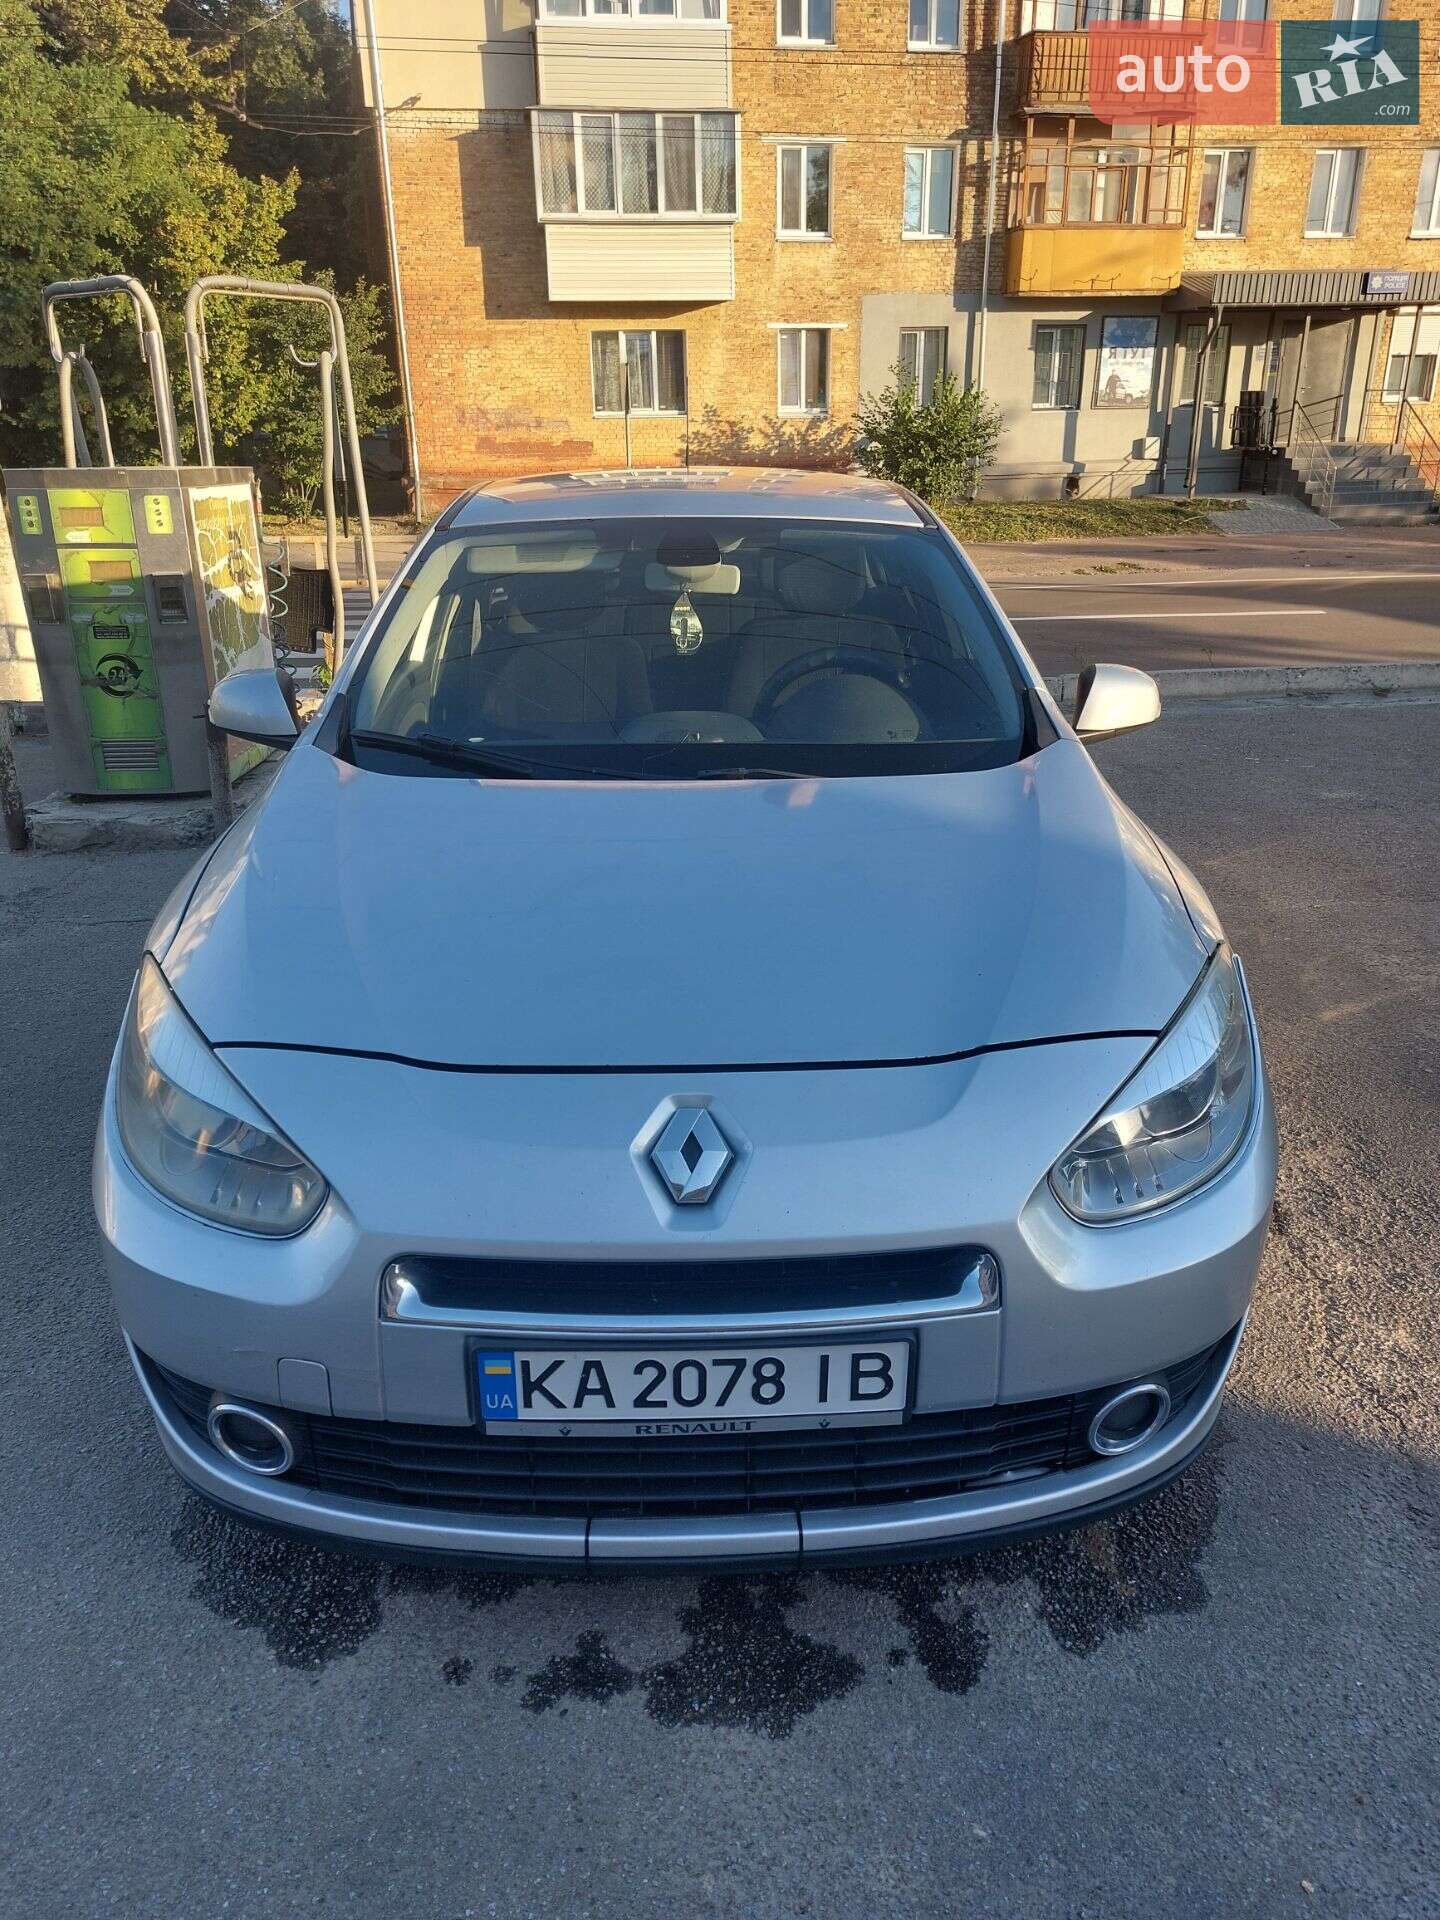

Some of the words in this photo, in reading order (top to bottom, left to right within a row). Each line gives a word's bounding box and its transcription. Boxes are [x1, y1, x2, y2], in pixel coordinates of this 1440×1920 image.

[520, 1360, 616, 1408] KA
[633, 1357, 785, 1408] 2078
[818, 1352, 894, 1403] IB
[486, 1394, 514, 1408] UA
[635, 1421, 757, 1435] RENAULT
